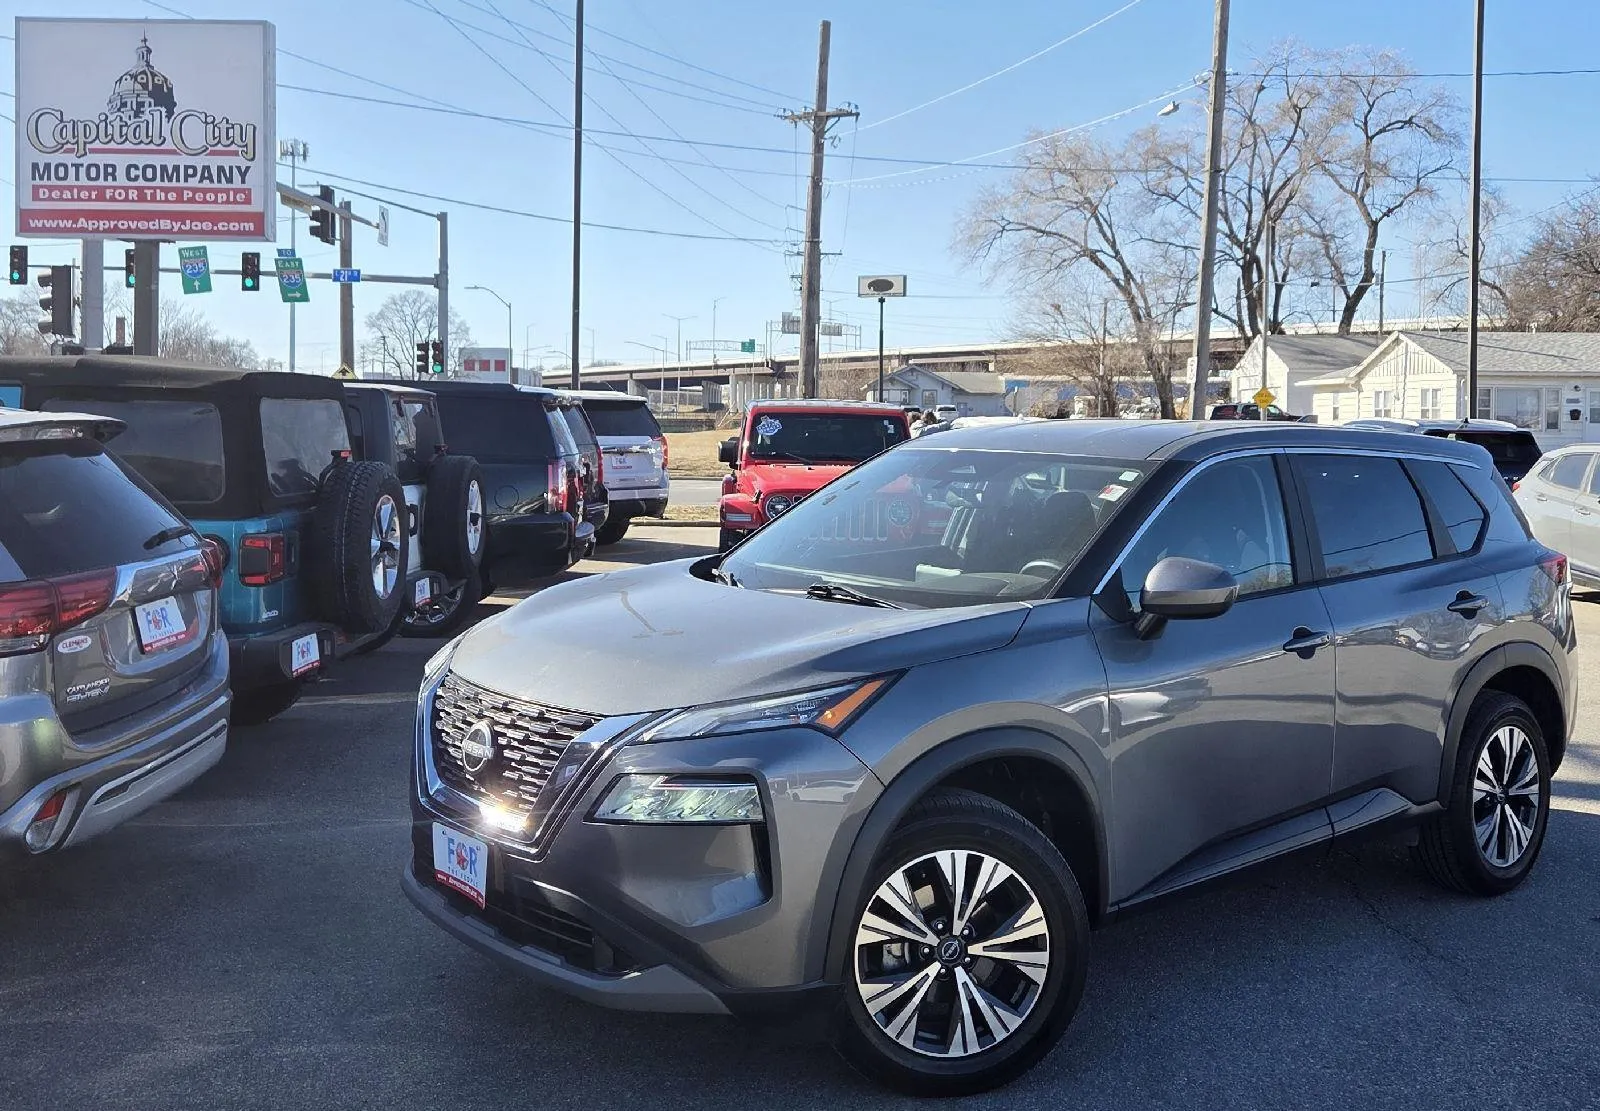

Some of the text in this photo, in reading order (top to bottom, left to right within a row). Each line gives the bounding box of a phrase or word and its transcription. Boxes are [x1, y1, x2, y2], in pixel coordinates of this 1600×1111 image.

[26, 107, 257, 161] Capital City
[31, 162, 251, 185] MOTOR COMPANY
[39, 188, 246, 203] Dealer FOR The People
[28, 217, 255, 232] www.ApprovedByJoe.com
[185, 261, 206, 274] 235
[277, 260, 300, 268] EAST
[282, 274, 302, 284] 235
[145, 607, 173, 632] FOR
[447, 837, 478, 877] FOR
